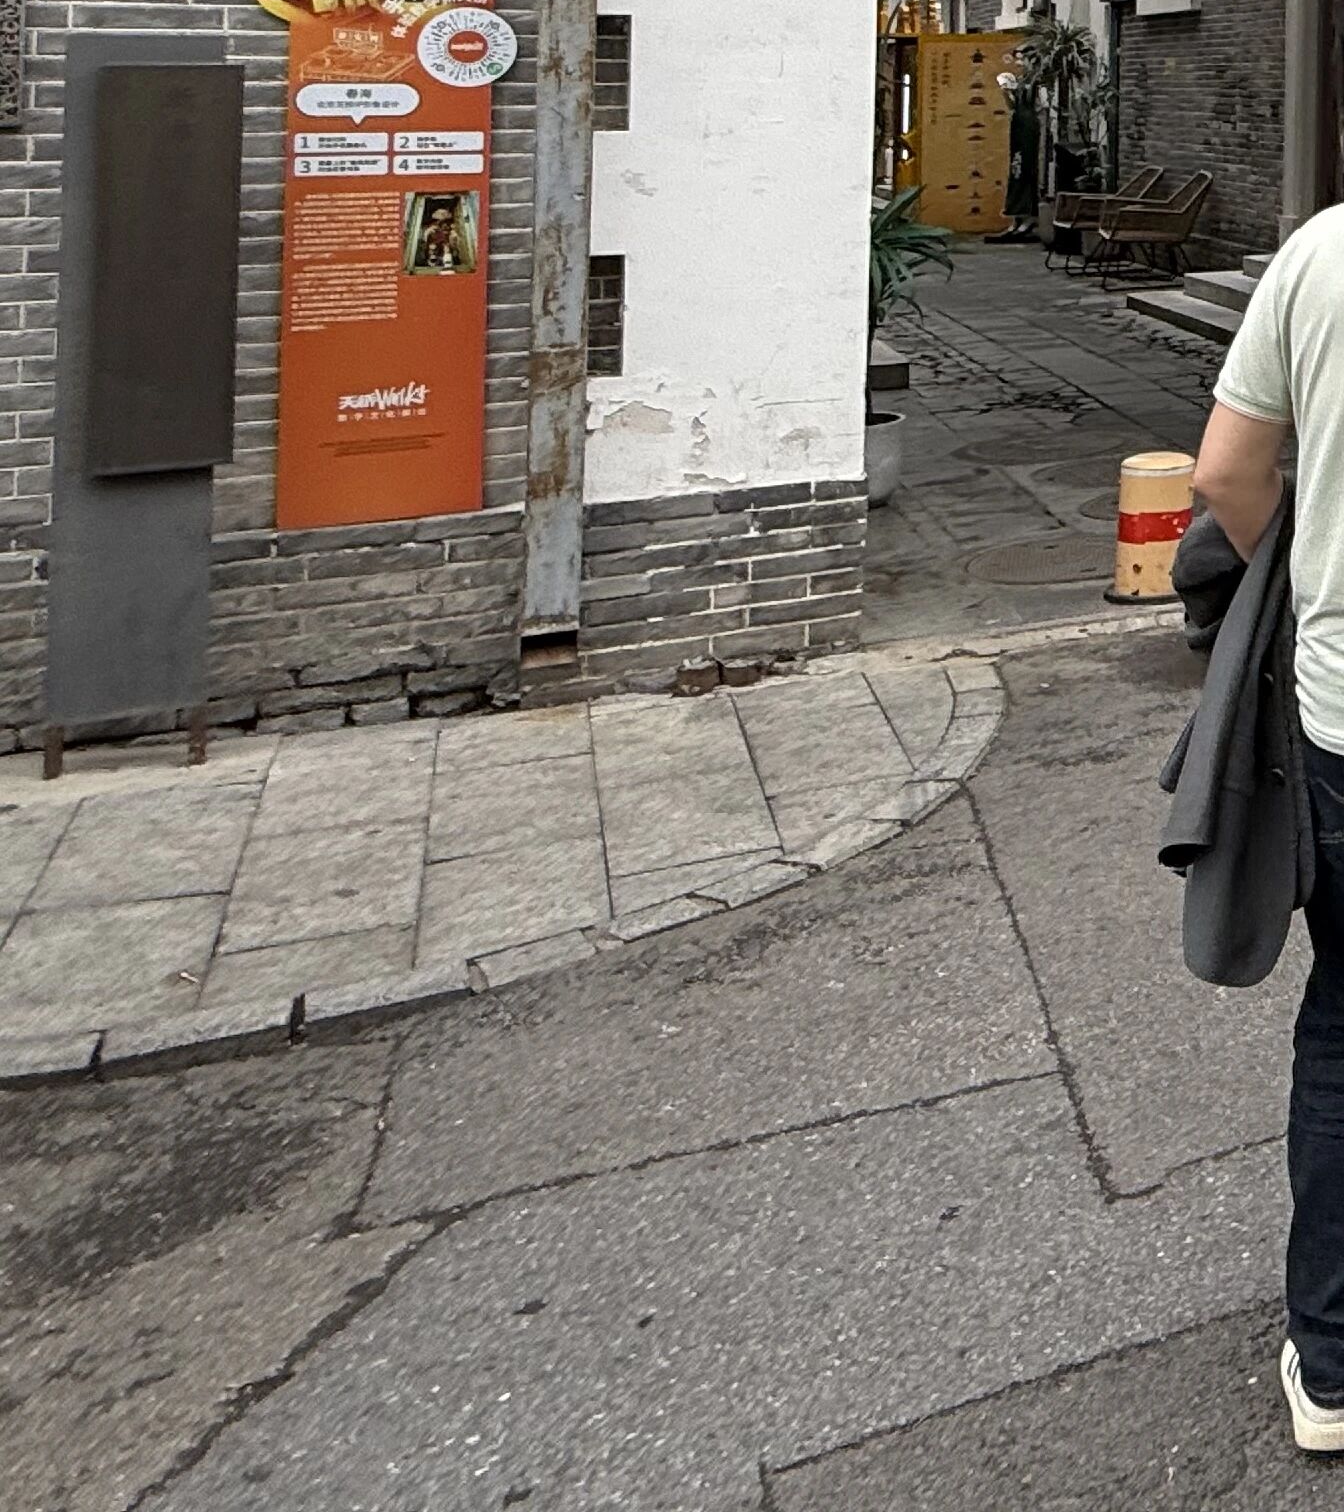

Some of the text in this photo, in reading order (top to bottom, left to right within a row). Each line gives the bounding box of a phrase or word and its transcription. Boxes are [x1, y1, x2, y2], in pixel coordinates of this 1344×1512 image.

[300, 136, 311, 149] 1
[399, 136, 410, 149] 2
[300, 160, 312, 174] 3
[398, 159, 410, 171] 4
